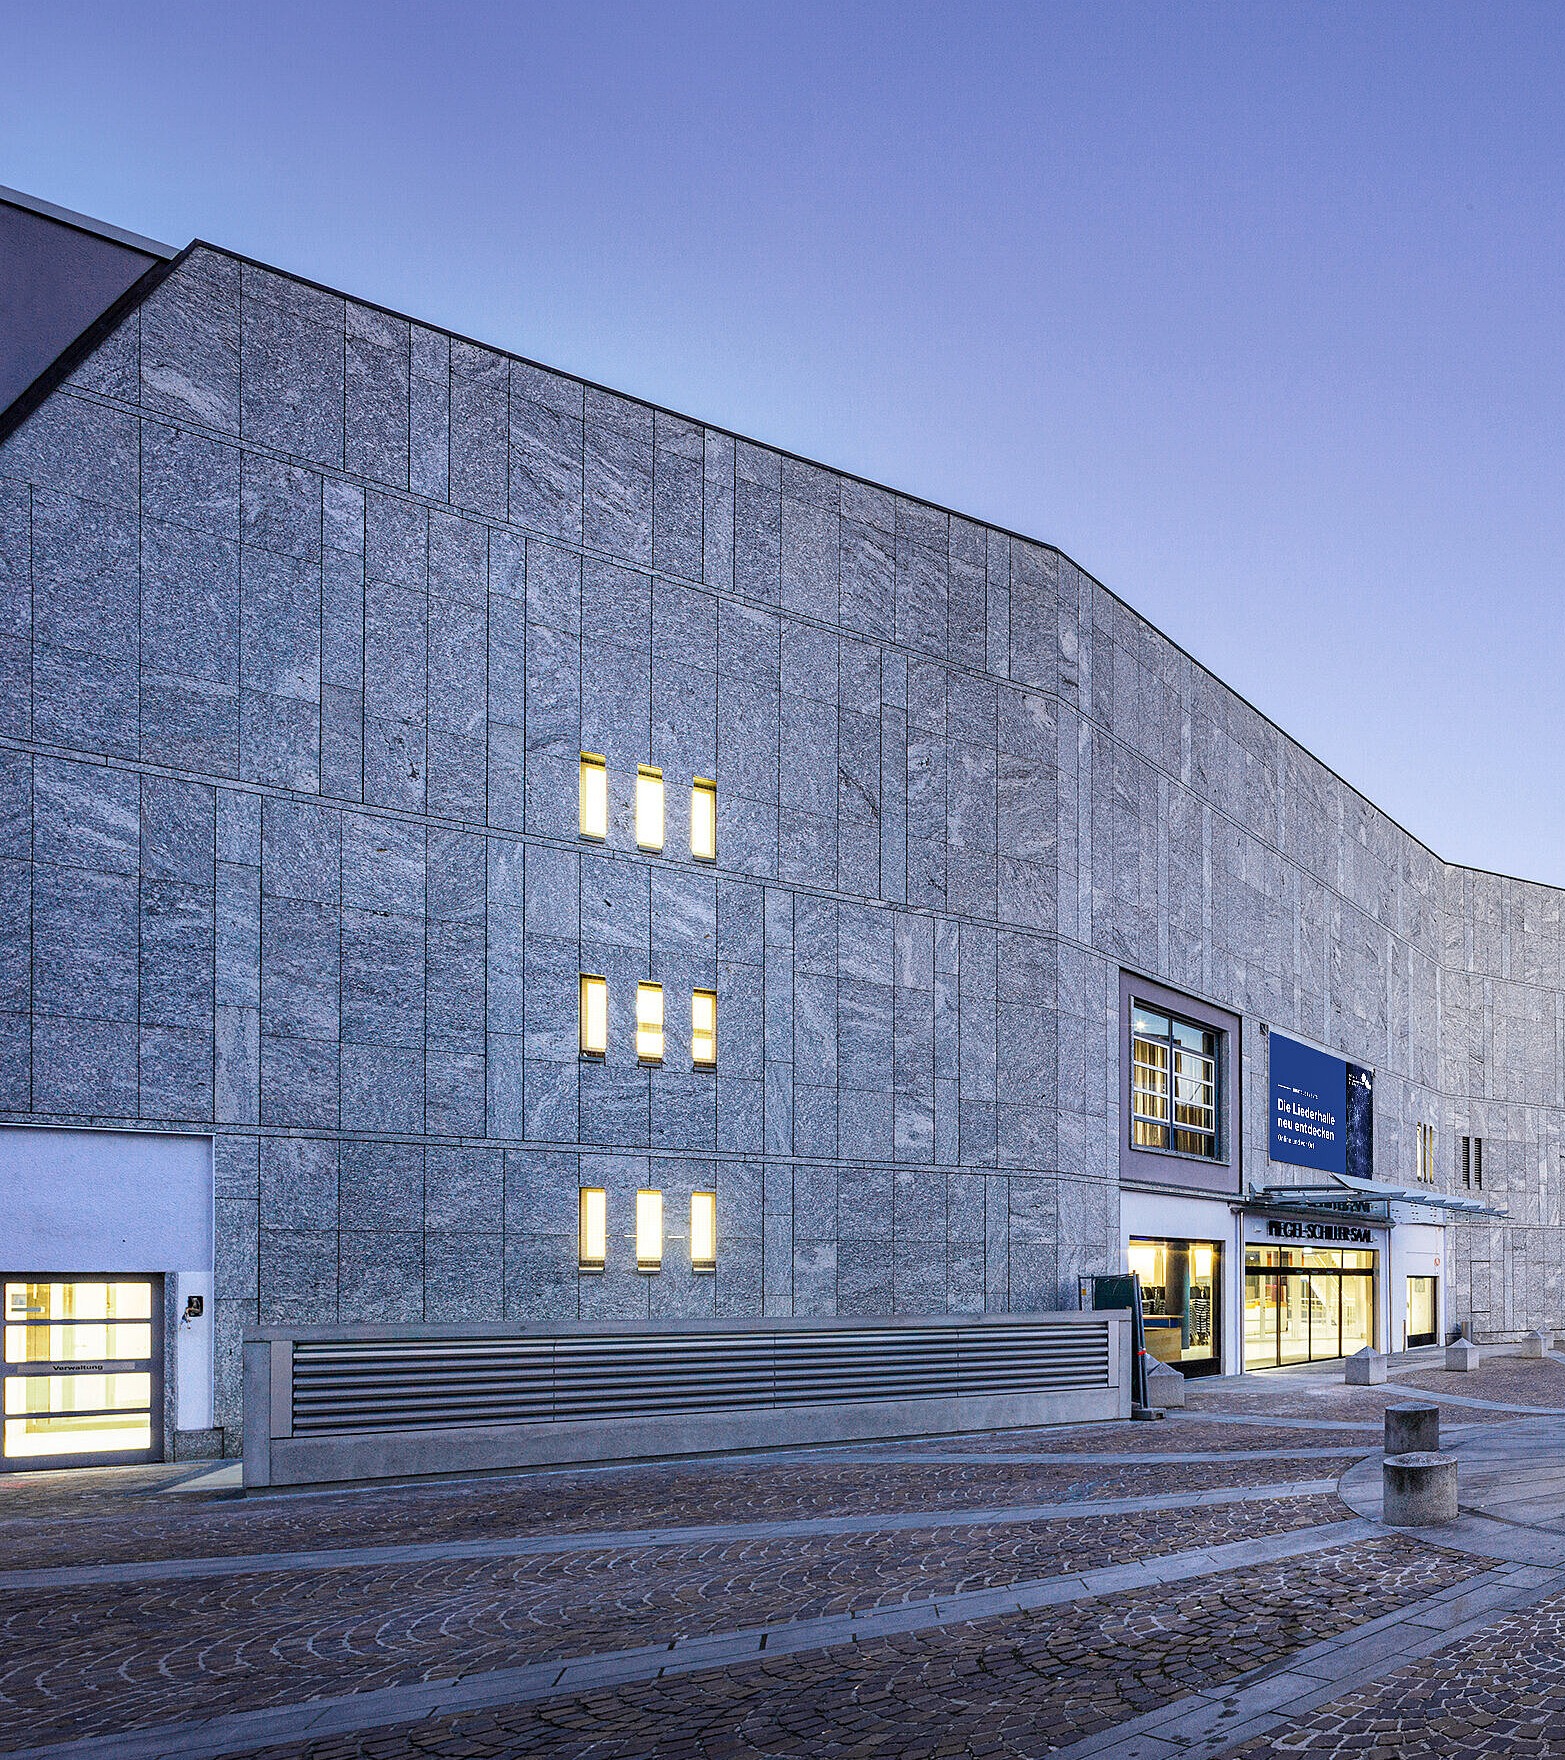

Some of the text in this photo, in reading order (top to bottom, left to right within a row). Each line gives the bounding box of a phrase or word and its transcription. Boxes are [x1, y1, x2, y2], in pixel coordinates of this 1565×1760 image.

[1277, 1098, 1336, 1126] Die Liederhalle
[1277, 1117, 1335, 1141] neu entdecken
[52, 1364, 104, 1372] Verwaltung
